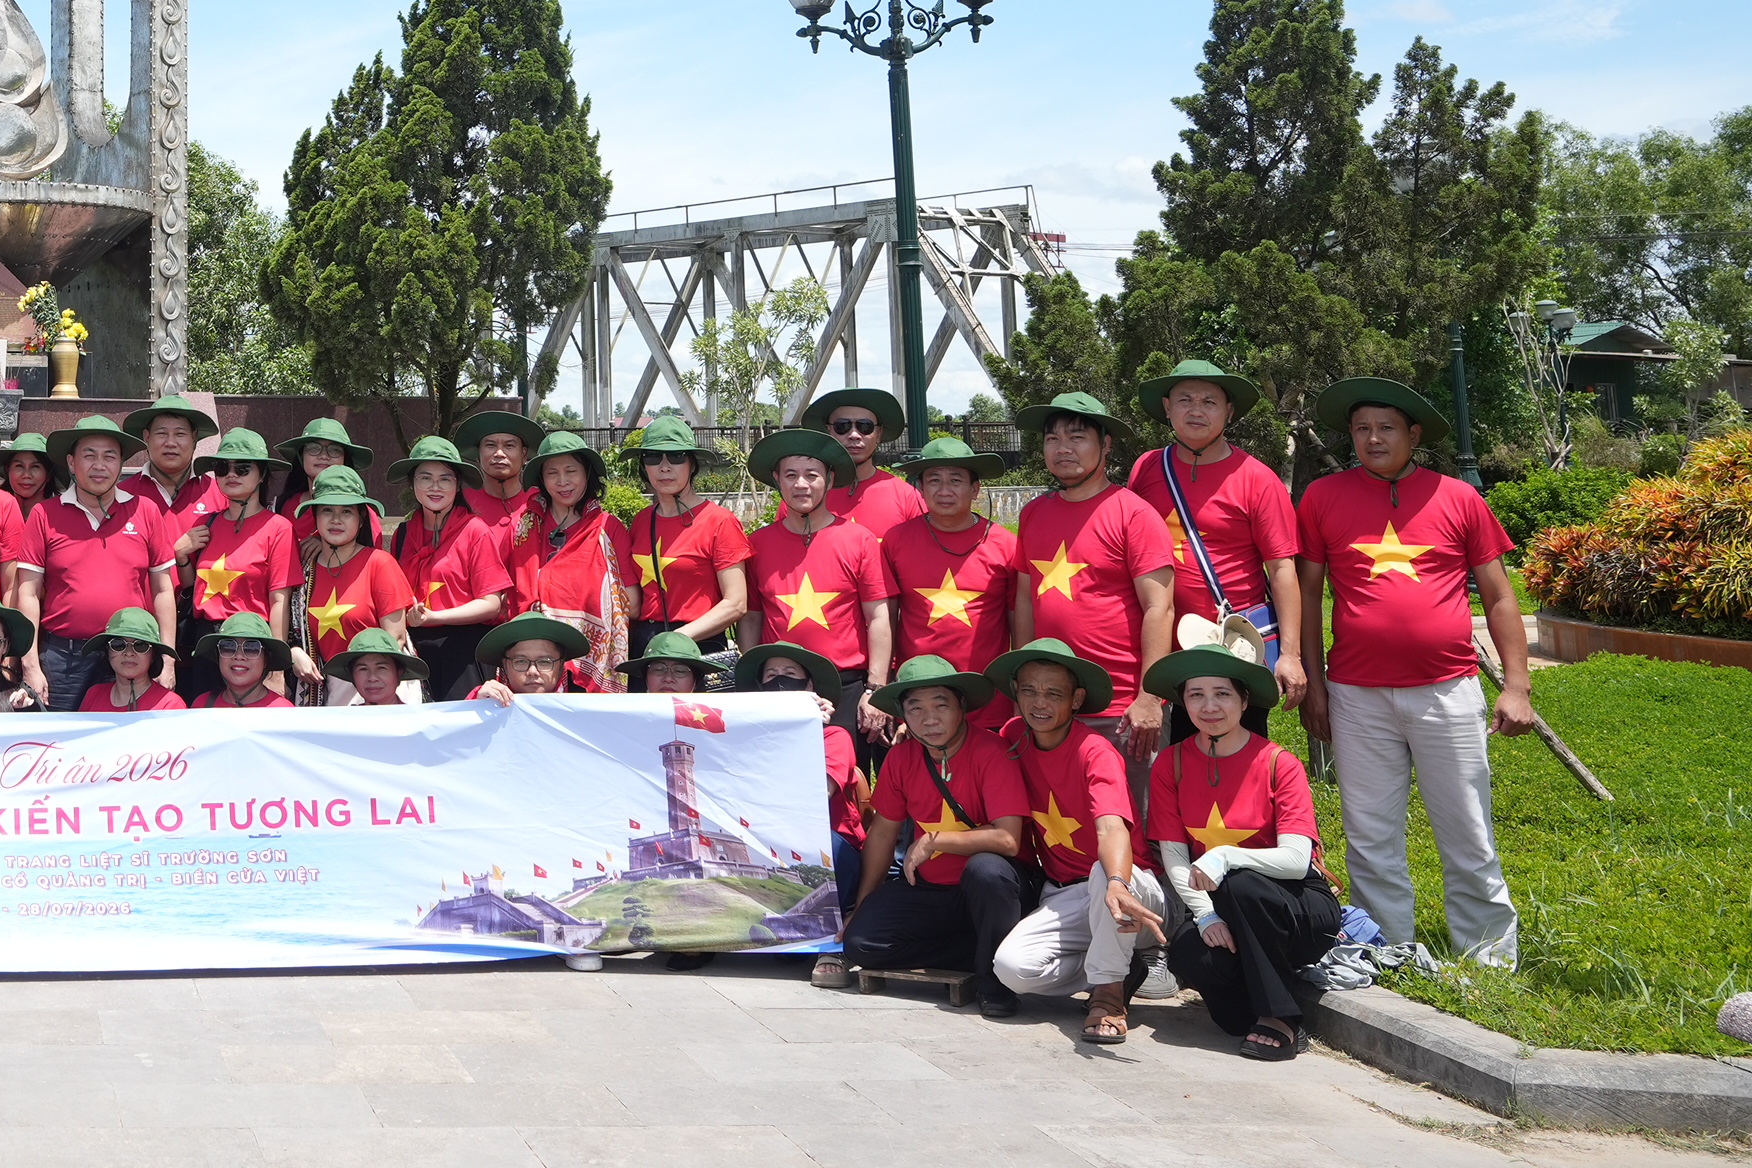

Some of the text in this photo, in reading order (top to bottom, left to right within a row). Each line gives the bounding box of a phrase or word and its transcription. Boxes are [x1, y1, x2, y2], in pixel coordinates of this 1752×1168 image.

[0, 741, 64, 789] Tri
[63, 756, 103, 784] ân
[106, 746, 195, 783] 2026
[99, 803, 184, 842] TẠO
[201, 796, 351, 832] TƯƠNG
[370, 795, 436, 826] LAI
[5, 854, 72, 869] TRANG
[79, 852, 123, 870] LIỆT
[130, 850, 150, 867] SĨ
[158, 850, 239, 866] TRƯỜNG
[247, 848, 288, 863] SƠN
[36, 870, 106, 890] QUẢNG
[114, 873, 147, 889] TRỊ
[227, 866, 267, 883] CỬA
[274, 866, 320, 884] VIỆT
[17, 901, 131, 917] 28/07/2026
